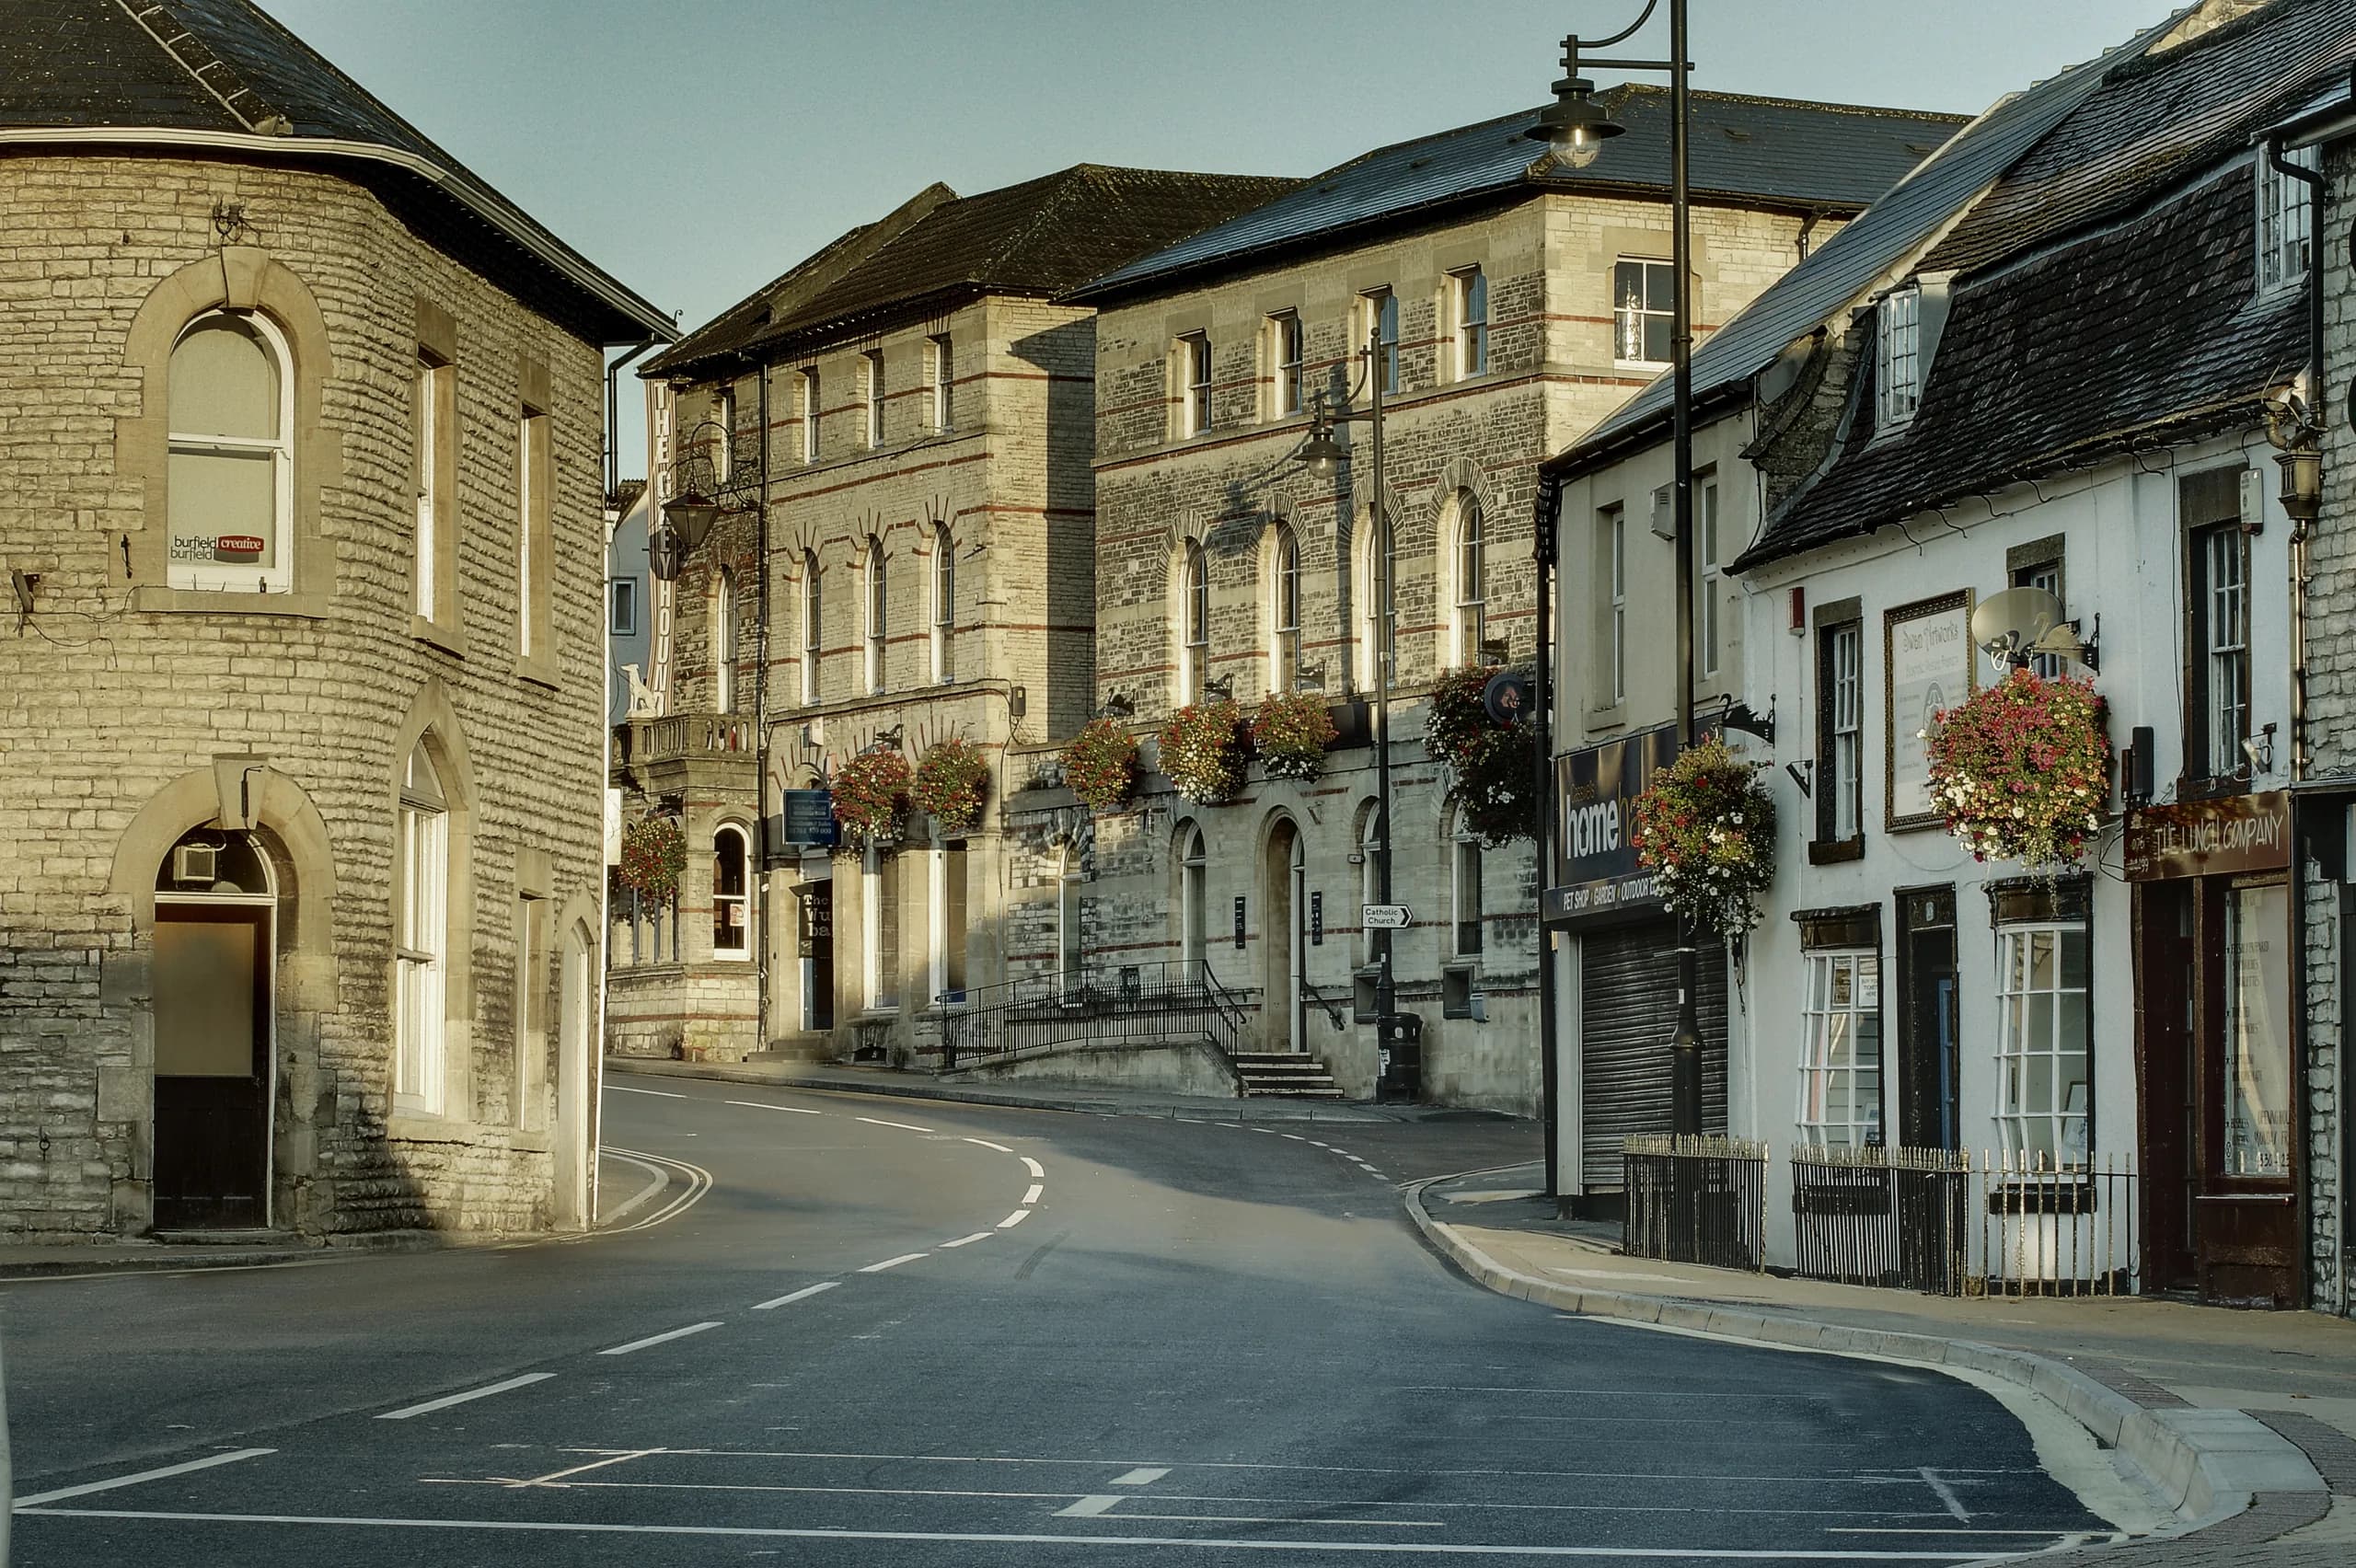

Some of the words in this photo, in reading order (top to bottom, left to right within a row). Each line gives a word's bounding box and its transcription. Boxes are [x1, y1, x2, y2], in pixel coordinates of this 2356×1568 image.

[655, 386, 670, 464] THE
[174, 535, 216, 549] burfield
[221, 537, 261, 549] creative
[2182, 815, 2221, 854] LUNCH
[2223, 810, 2283, 855] COMPANY
[803, 894, 829, 905] The
[1563, 891, 1574, 912] PET
[1575, 889, 1590, 910] SHOP
[1593, 883, 1617, 906] GARDEN
[1621, 878, 1648, 902] OUTDOOR
[1368, 917, 1396, 925] Church
